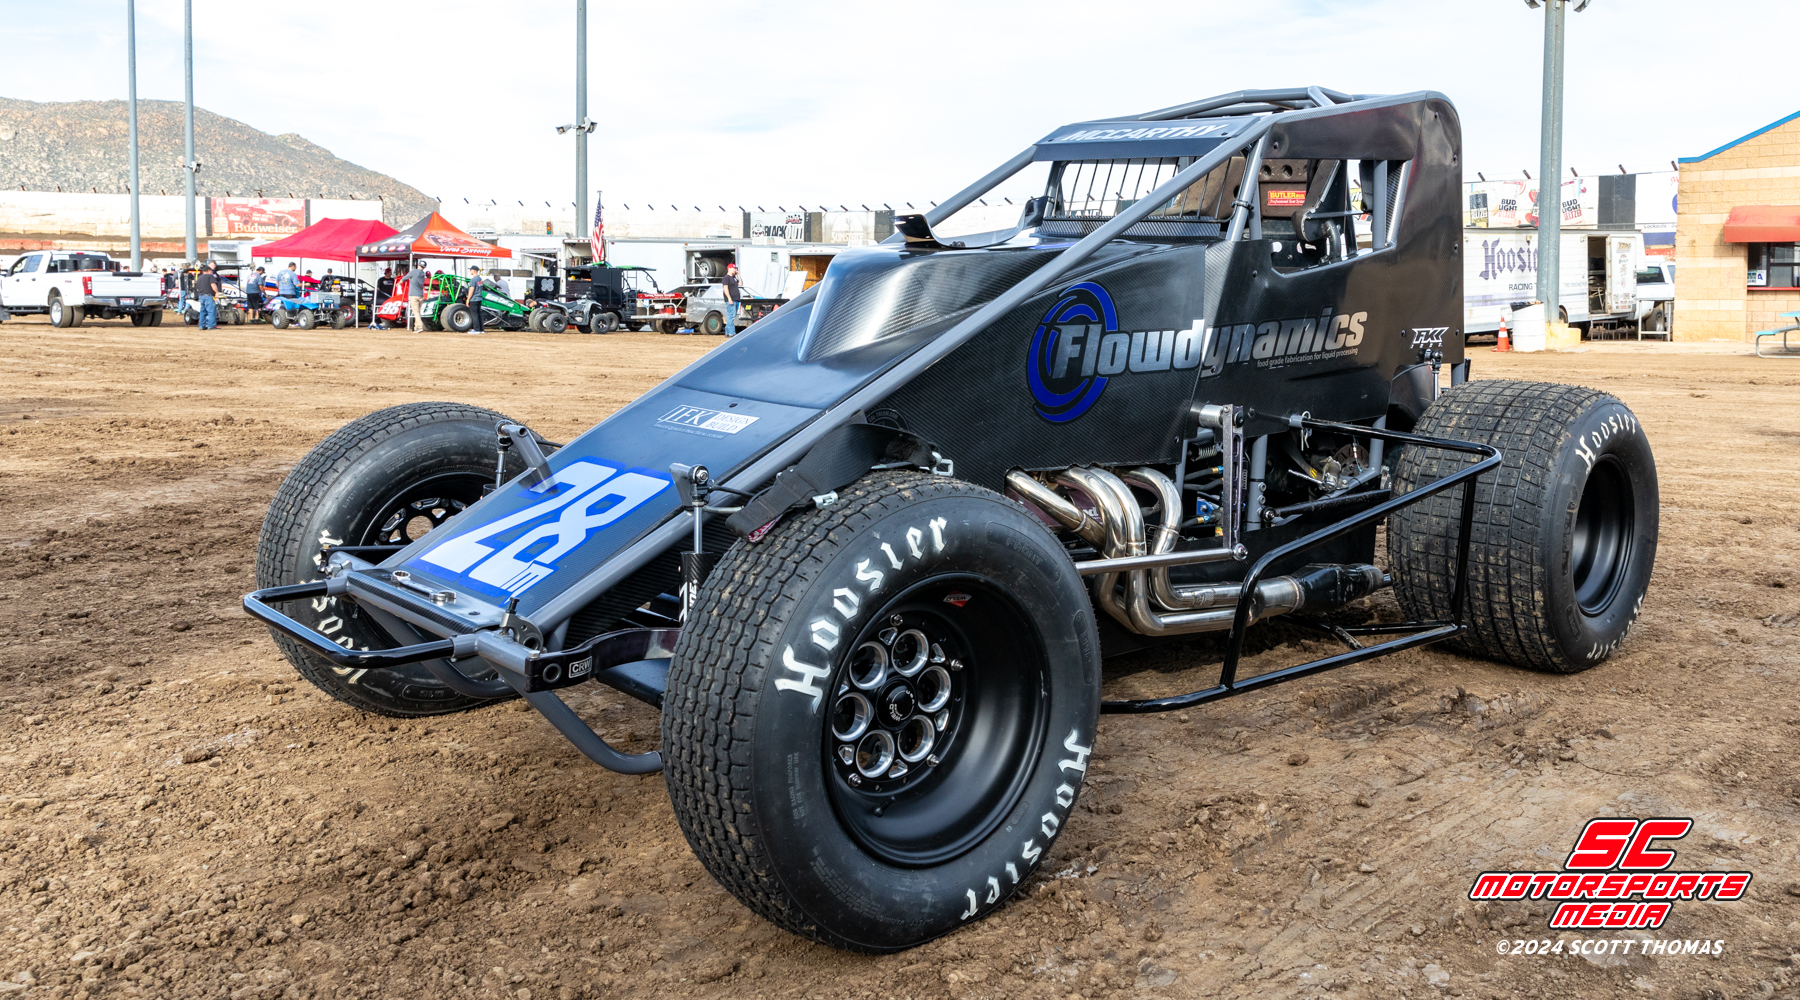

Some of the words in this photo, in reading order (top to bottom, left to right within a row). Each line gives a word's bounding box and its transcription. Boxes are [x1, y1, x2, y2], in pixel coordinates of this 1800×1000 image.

[1061, 124, 1230, 141] MCCARTHY
[1501, 198, 1517, 206] BUD
[1562, 198, 1578, 208] BUD
[1563, 209, 1582, 221] SELTZER
[1508, 283, 1533, 291] RACING
[1052, 307, 1368, 378] Flowdynamics
[1257, 360, 1269, 368] food
[1269, 358, 1284, 368] grade
[1284, 354, 1314, 364] fabrication
[1321, 350, 1336, 359] liquid
[1335, 347, 1359, 358] processing
[706, 421, 738, 431] BUILD
[714, 413, 750, 425] DESIGN
[1575, 413, 1637, 475] Hoosier
[774, 516, 948, 715] Hoosier
[572, 659, 590, 673] CRW
[960, 729, 1092, 920] Hoosier
